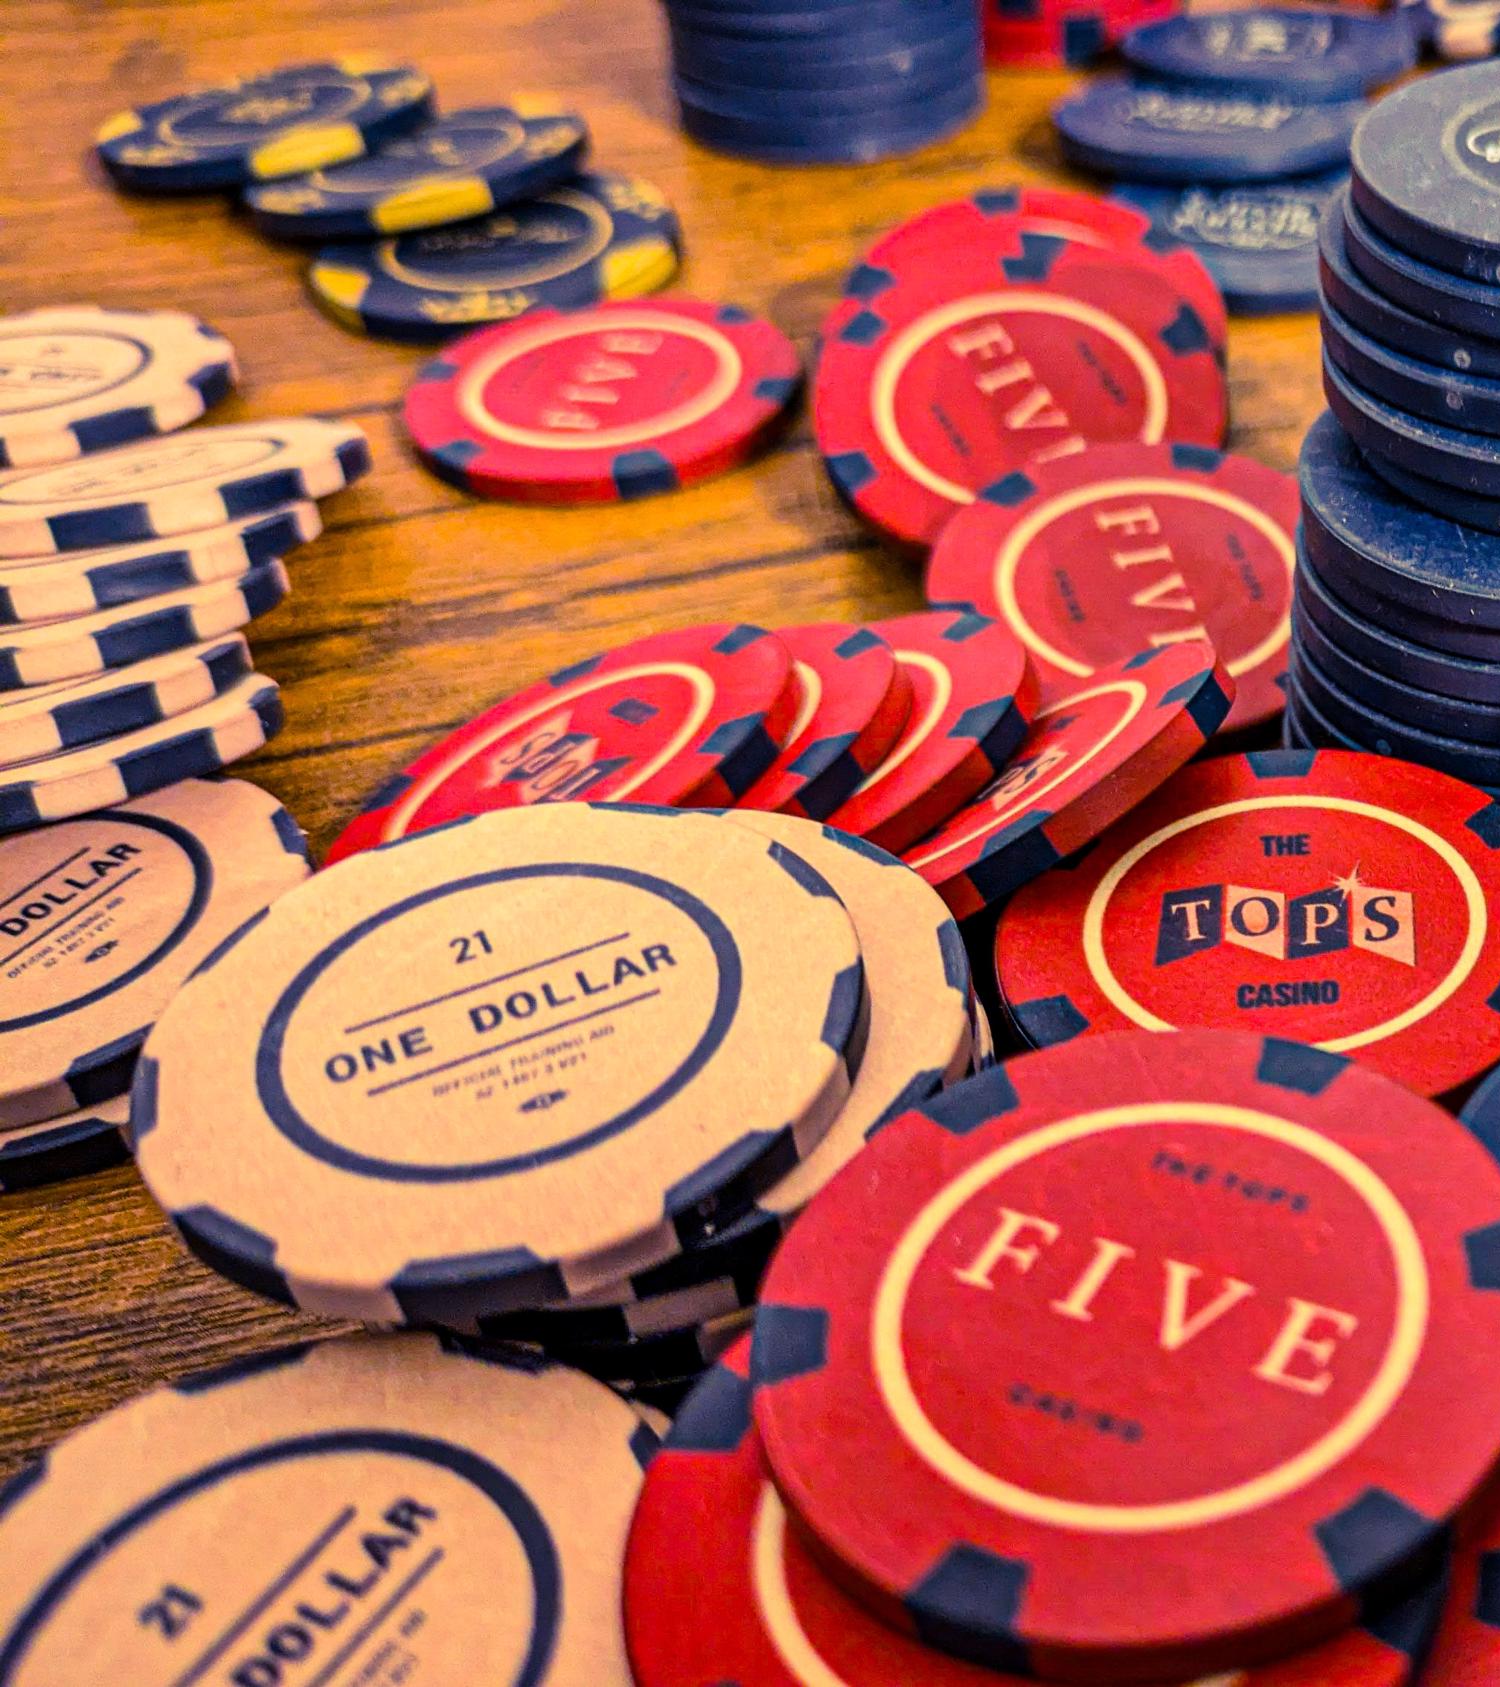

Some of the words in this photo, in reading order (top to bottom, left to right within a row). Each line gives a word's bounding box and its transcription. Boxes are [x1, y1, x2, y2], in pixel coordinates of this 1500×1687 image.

[1260, 833, 1311, 857] THE
[0, 843, 142, 937] DOLLAR
[449, 929, 493, 965] 21
[1171, 895, 1400, 946] TOPS
[325, 1026, 434, 1083] ONE
[468, 942, 677, 1034] DOLLAR
[1236, 980, 1340, 1010] CASINO
[953, 1206, 1360, 1396] FIVE
[136, 1582, 203, 1641] 21
[229, 1497, 437, 1687] DOLLAR
